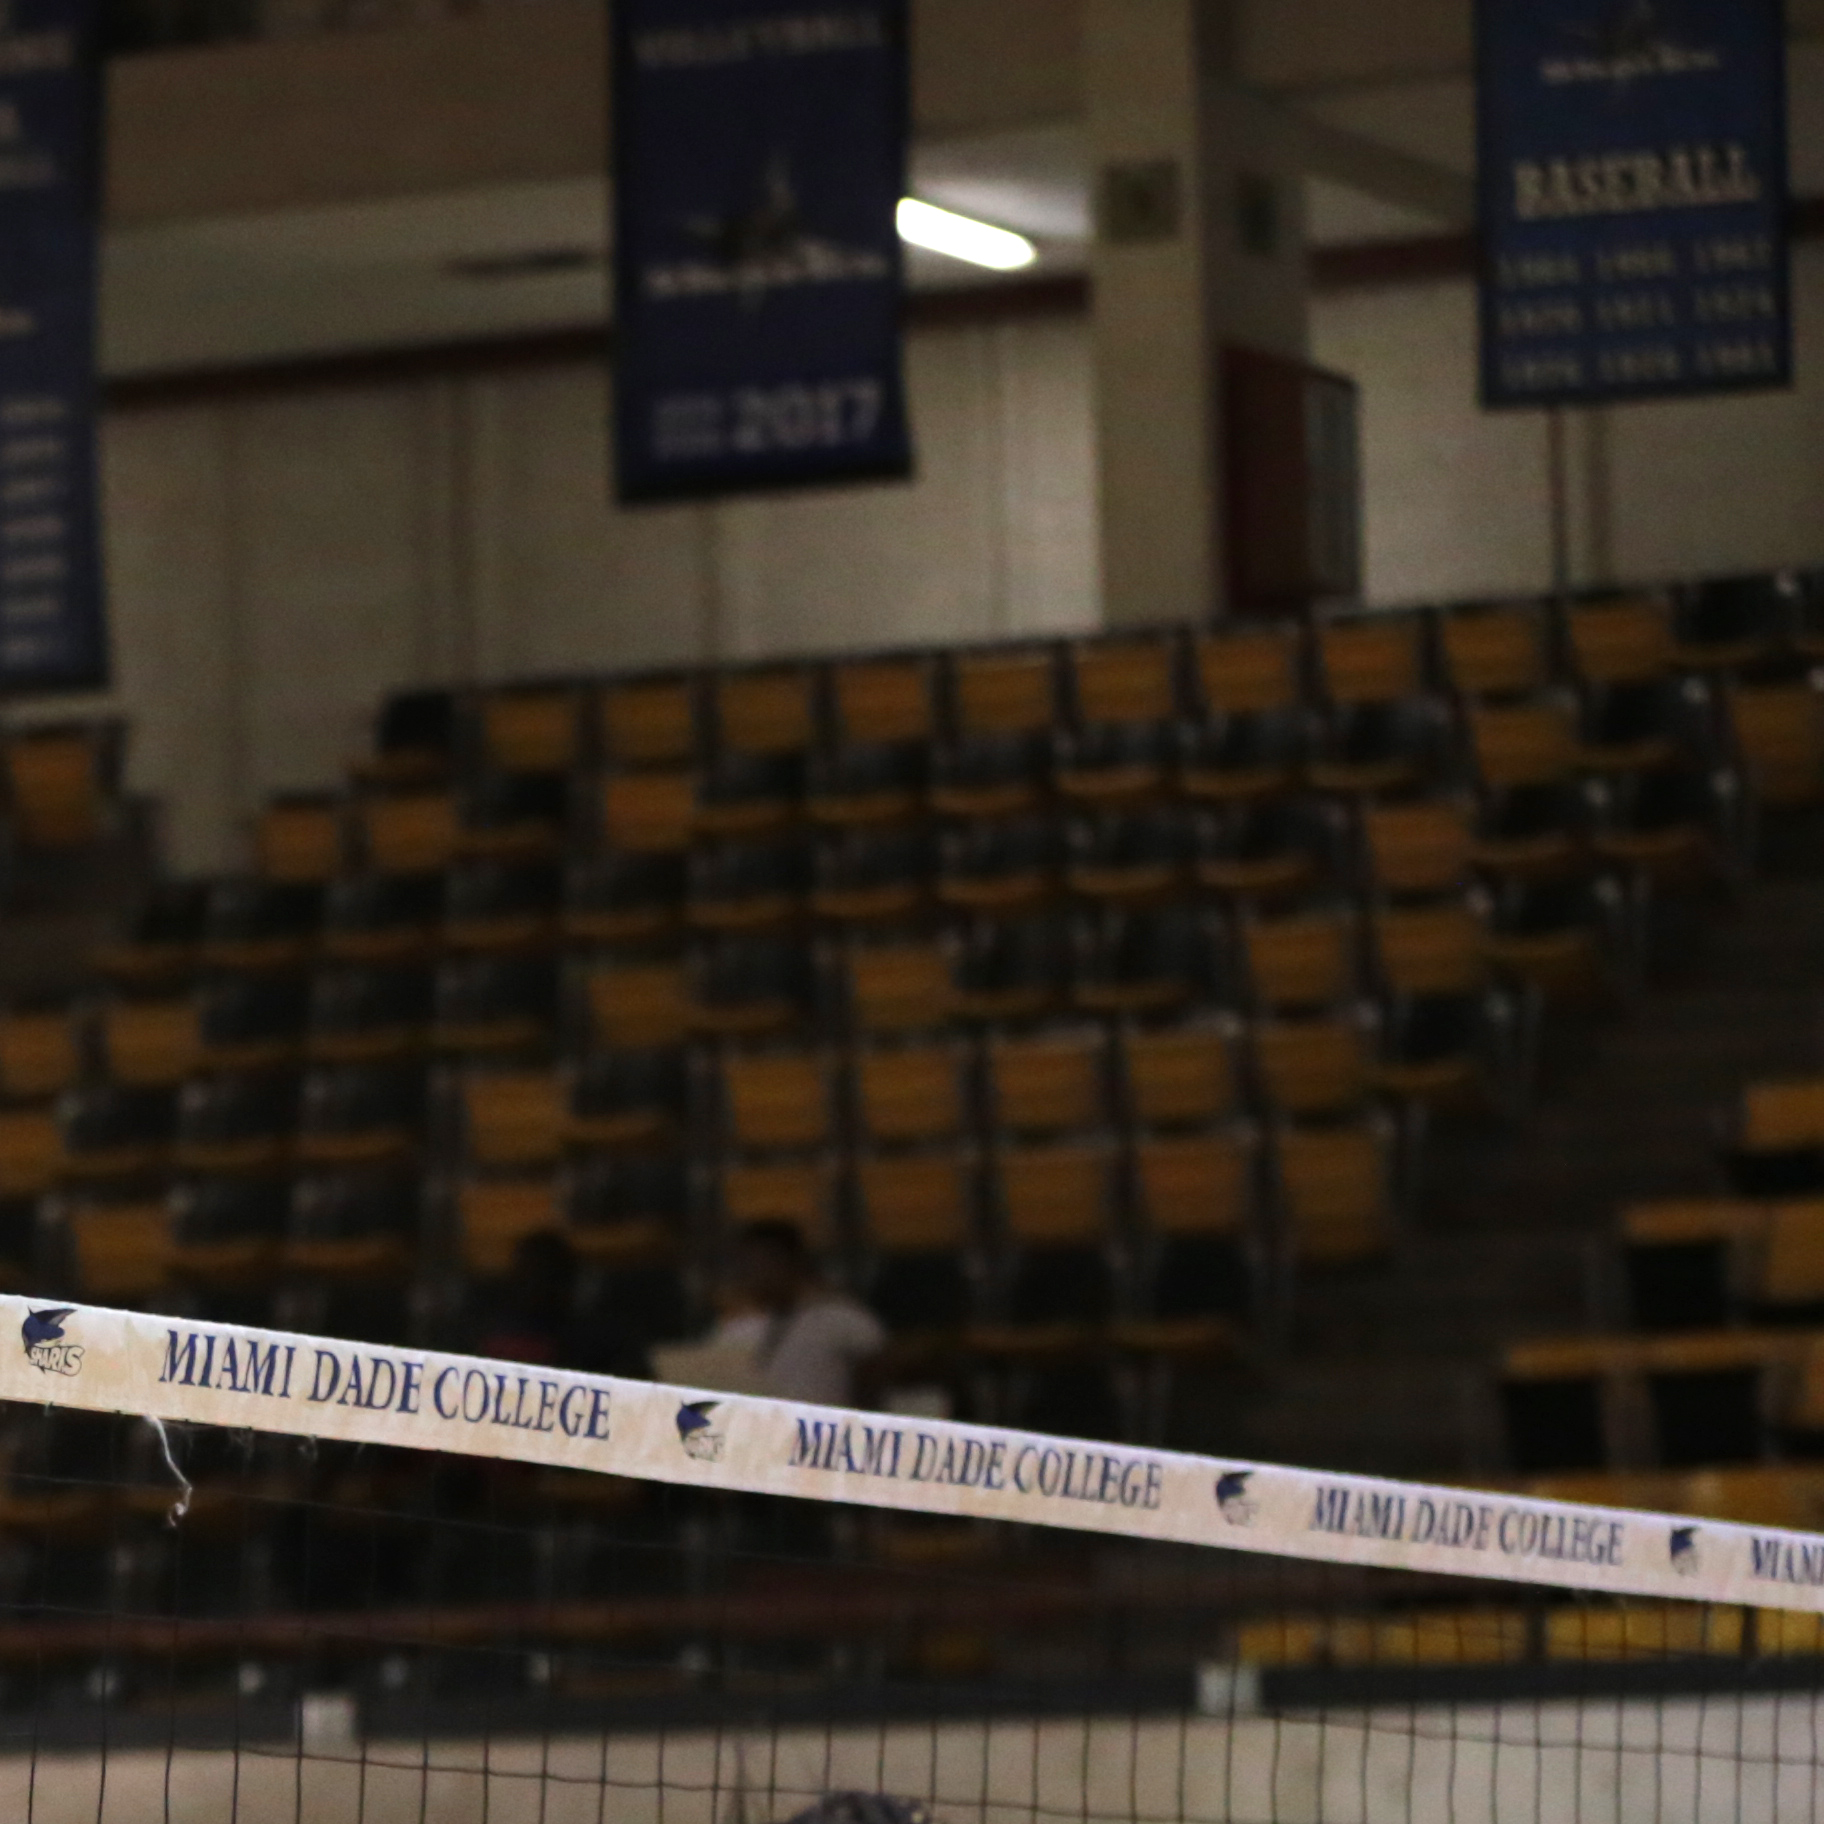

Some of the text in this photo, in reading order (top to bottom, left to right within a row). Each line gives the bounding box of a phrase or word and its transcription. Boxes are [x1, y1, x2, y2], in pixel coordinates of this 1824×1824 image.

[159, 1329, 611, 1441] MIAMI DADE COLLEGE
[788, 1418, 903, 1476] MIAMI
[911, 1433, 1007, 1490] DADE
[1013, 1446, 1163, 1511] COLLEGE
[1310, 1487, 1405, 1540] MIAMI
[1411, 1497, 1494, 1550] DADE
[1498, 1506, 1625, 1566] COLLEGE
